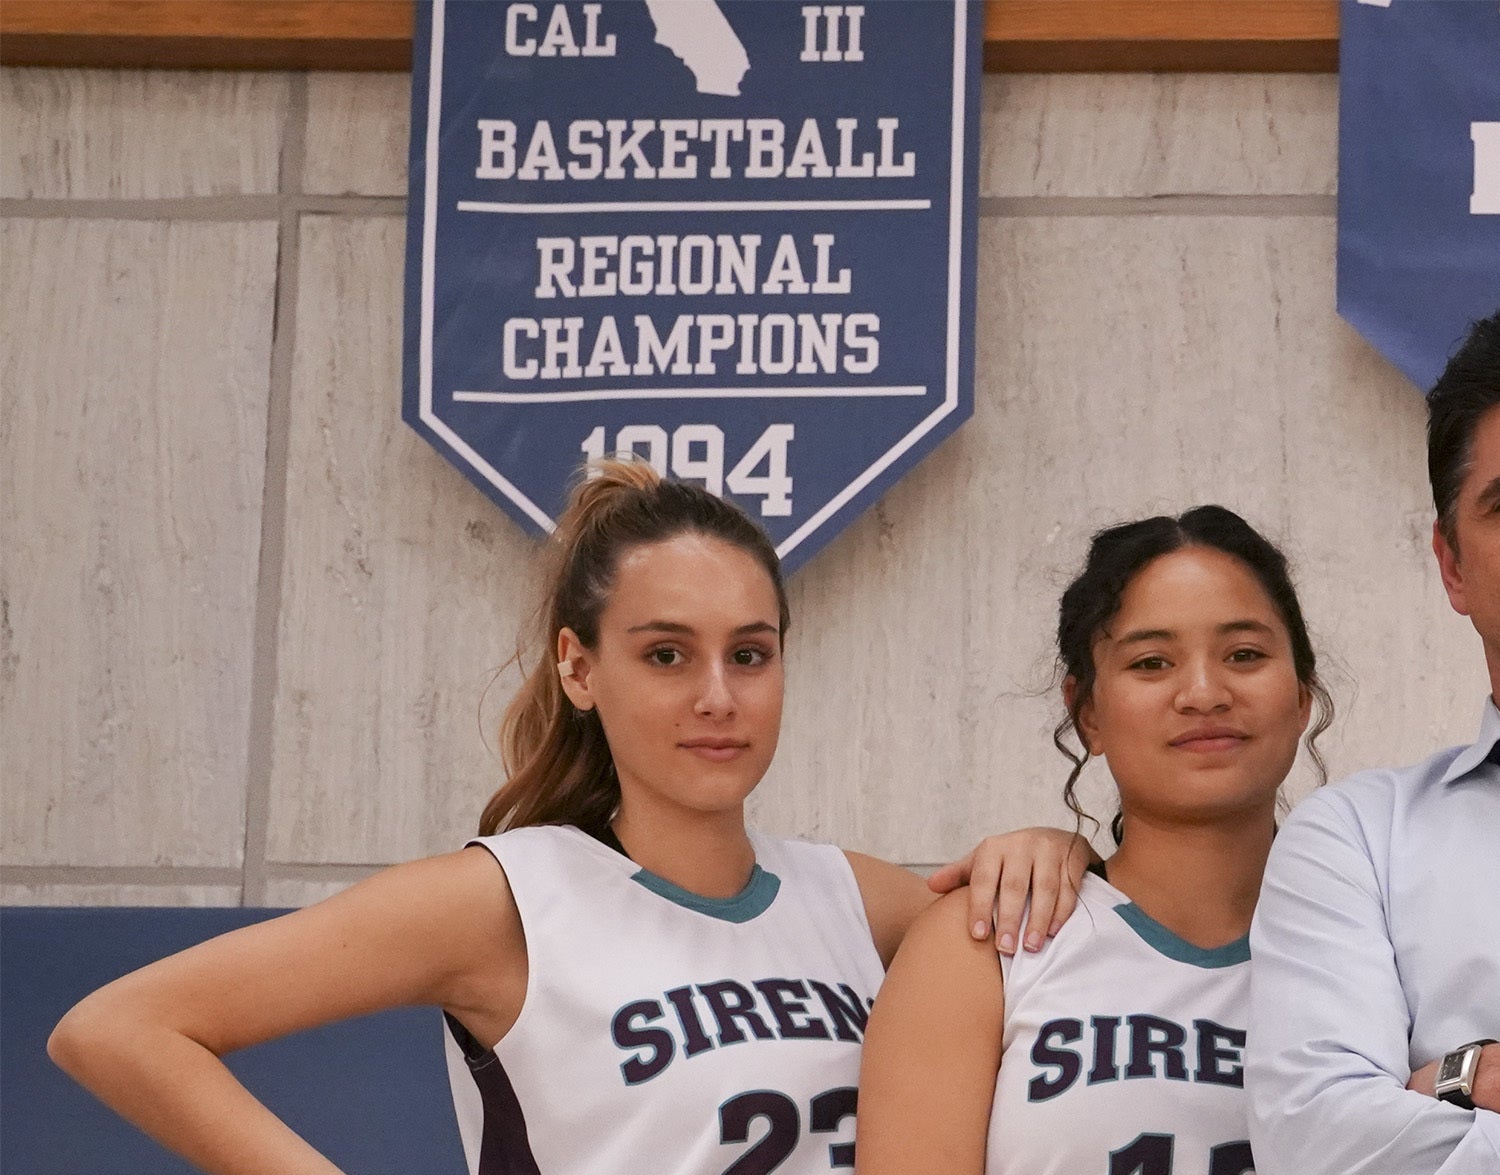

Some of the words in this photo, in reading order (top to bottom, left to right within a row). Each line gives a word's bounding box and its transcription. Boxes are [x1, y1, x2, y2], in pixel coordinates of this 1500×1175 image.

[506, 4, 617, 57] CAL
[801, 6, 865, 62] III
[475, 118, 917, 181] BASKETBALL
[535, 234, 852, 298] REGIONAL
[503, 314, 881, 380] CHAMPIONS
[611, 978, 875, 1087] SIREN
